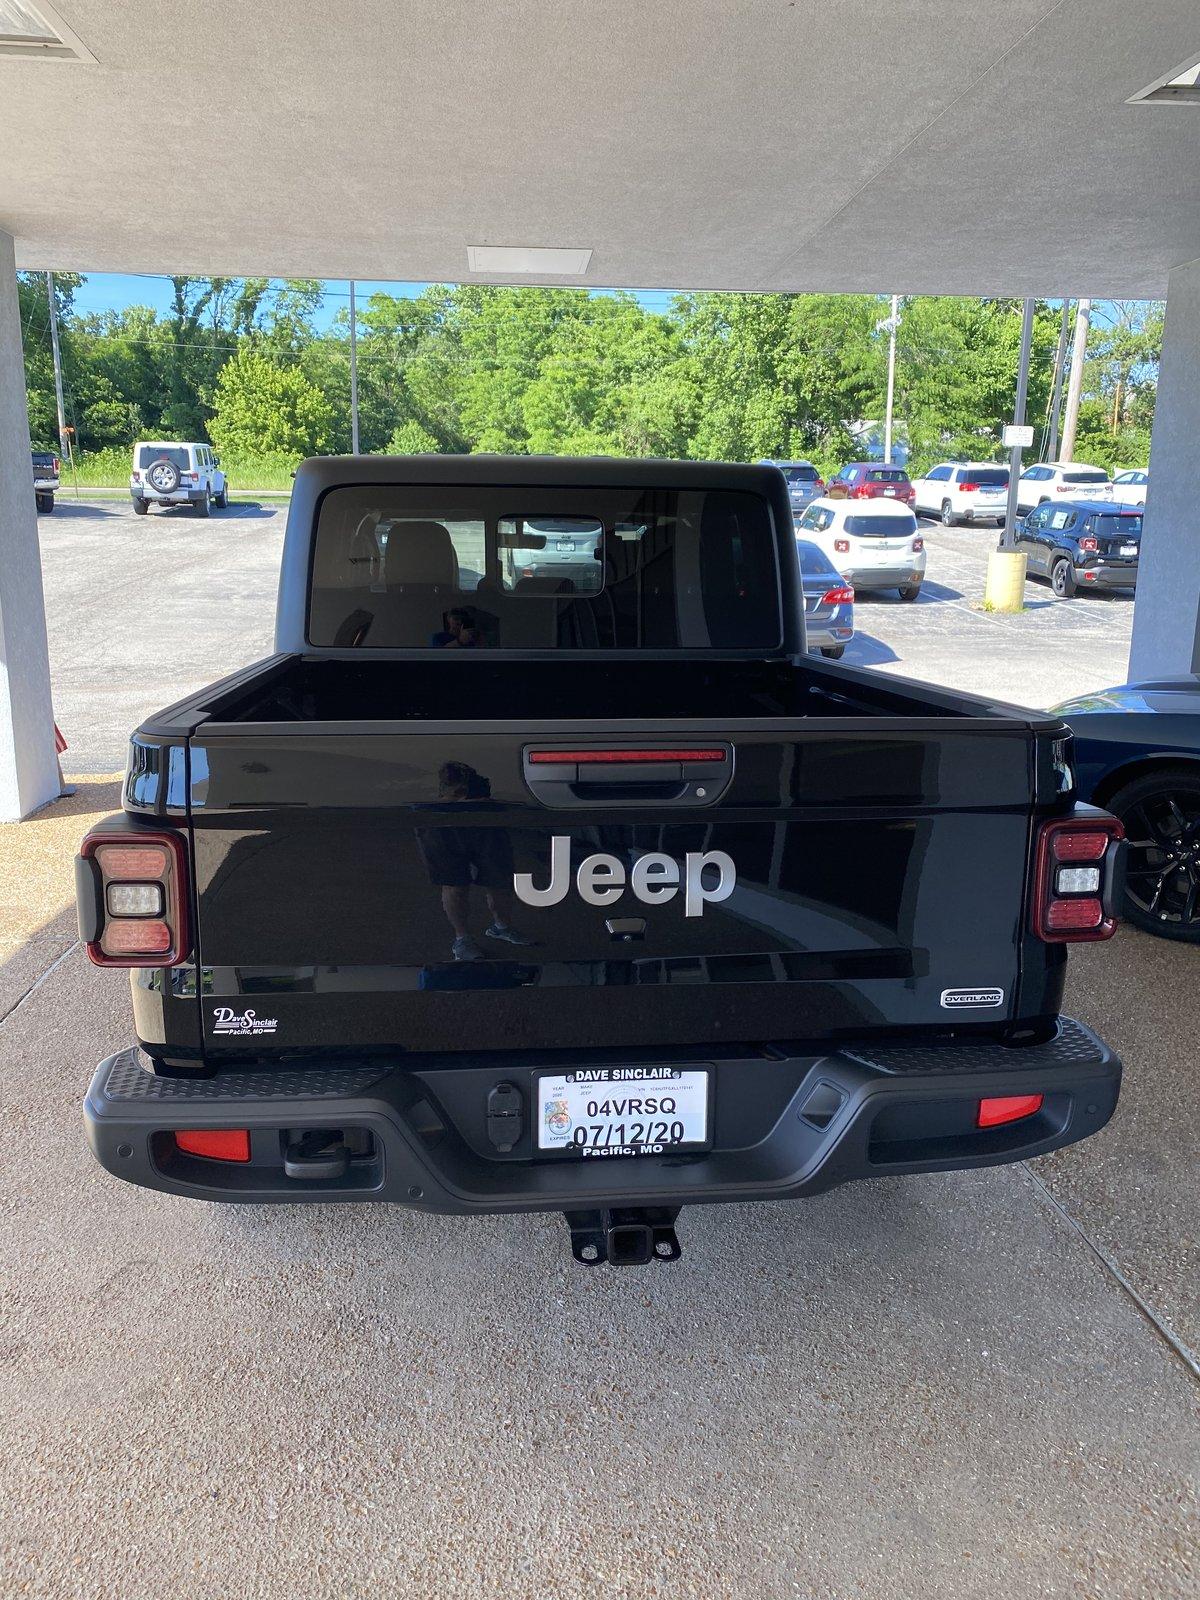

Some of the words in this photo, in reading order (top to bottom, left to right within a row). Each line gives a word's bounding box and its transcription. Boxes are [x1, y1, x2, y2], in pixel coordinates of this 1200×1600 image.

[513, 835, 737, 917] Jeep
[213, 1007, 245, 1022] Dave
[240, 1009, 278, 1028] Sinclair
[576, 1070, 609, 1082] DAVE
[612, 1068, 672, 1081] SINCLAIR
[587, 1097, 677, 1117] 04VRSQ
[573, 1121, 685, 1147] 07/12/20
[582, 1146, 636, 1157] Pacific,
[640, 1144, 664, 1154] MO
